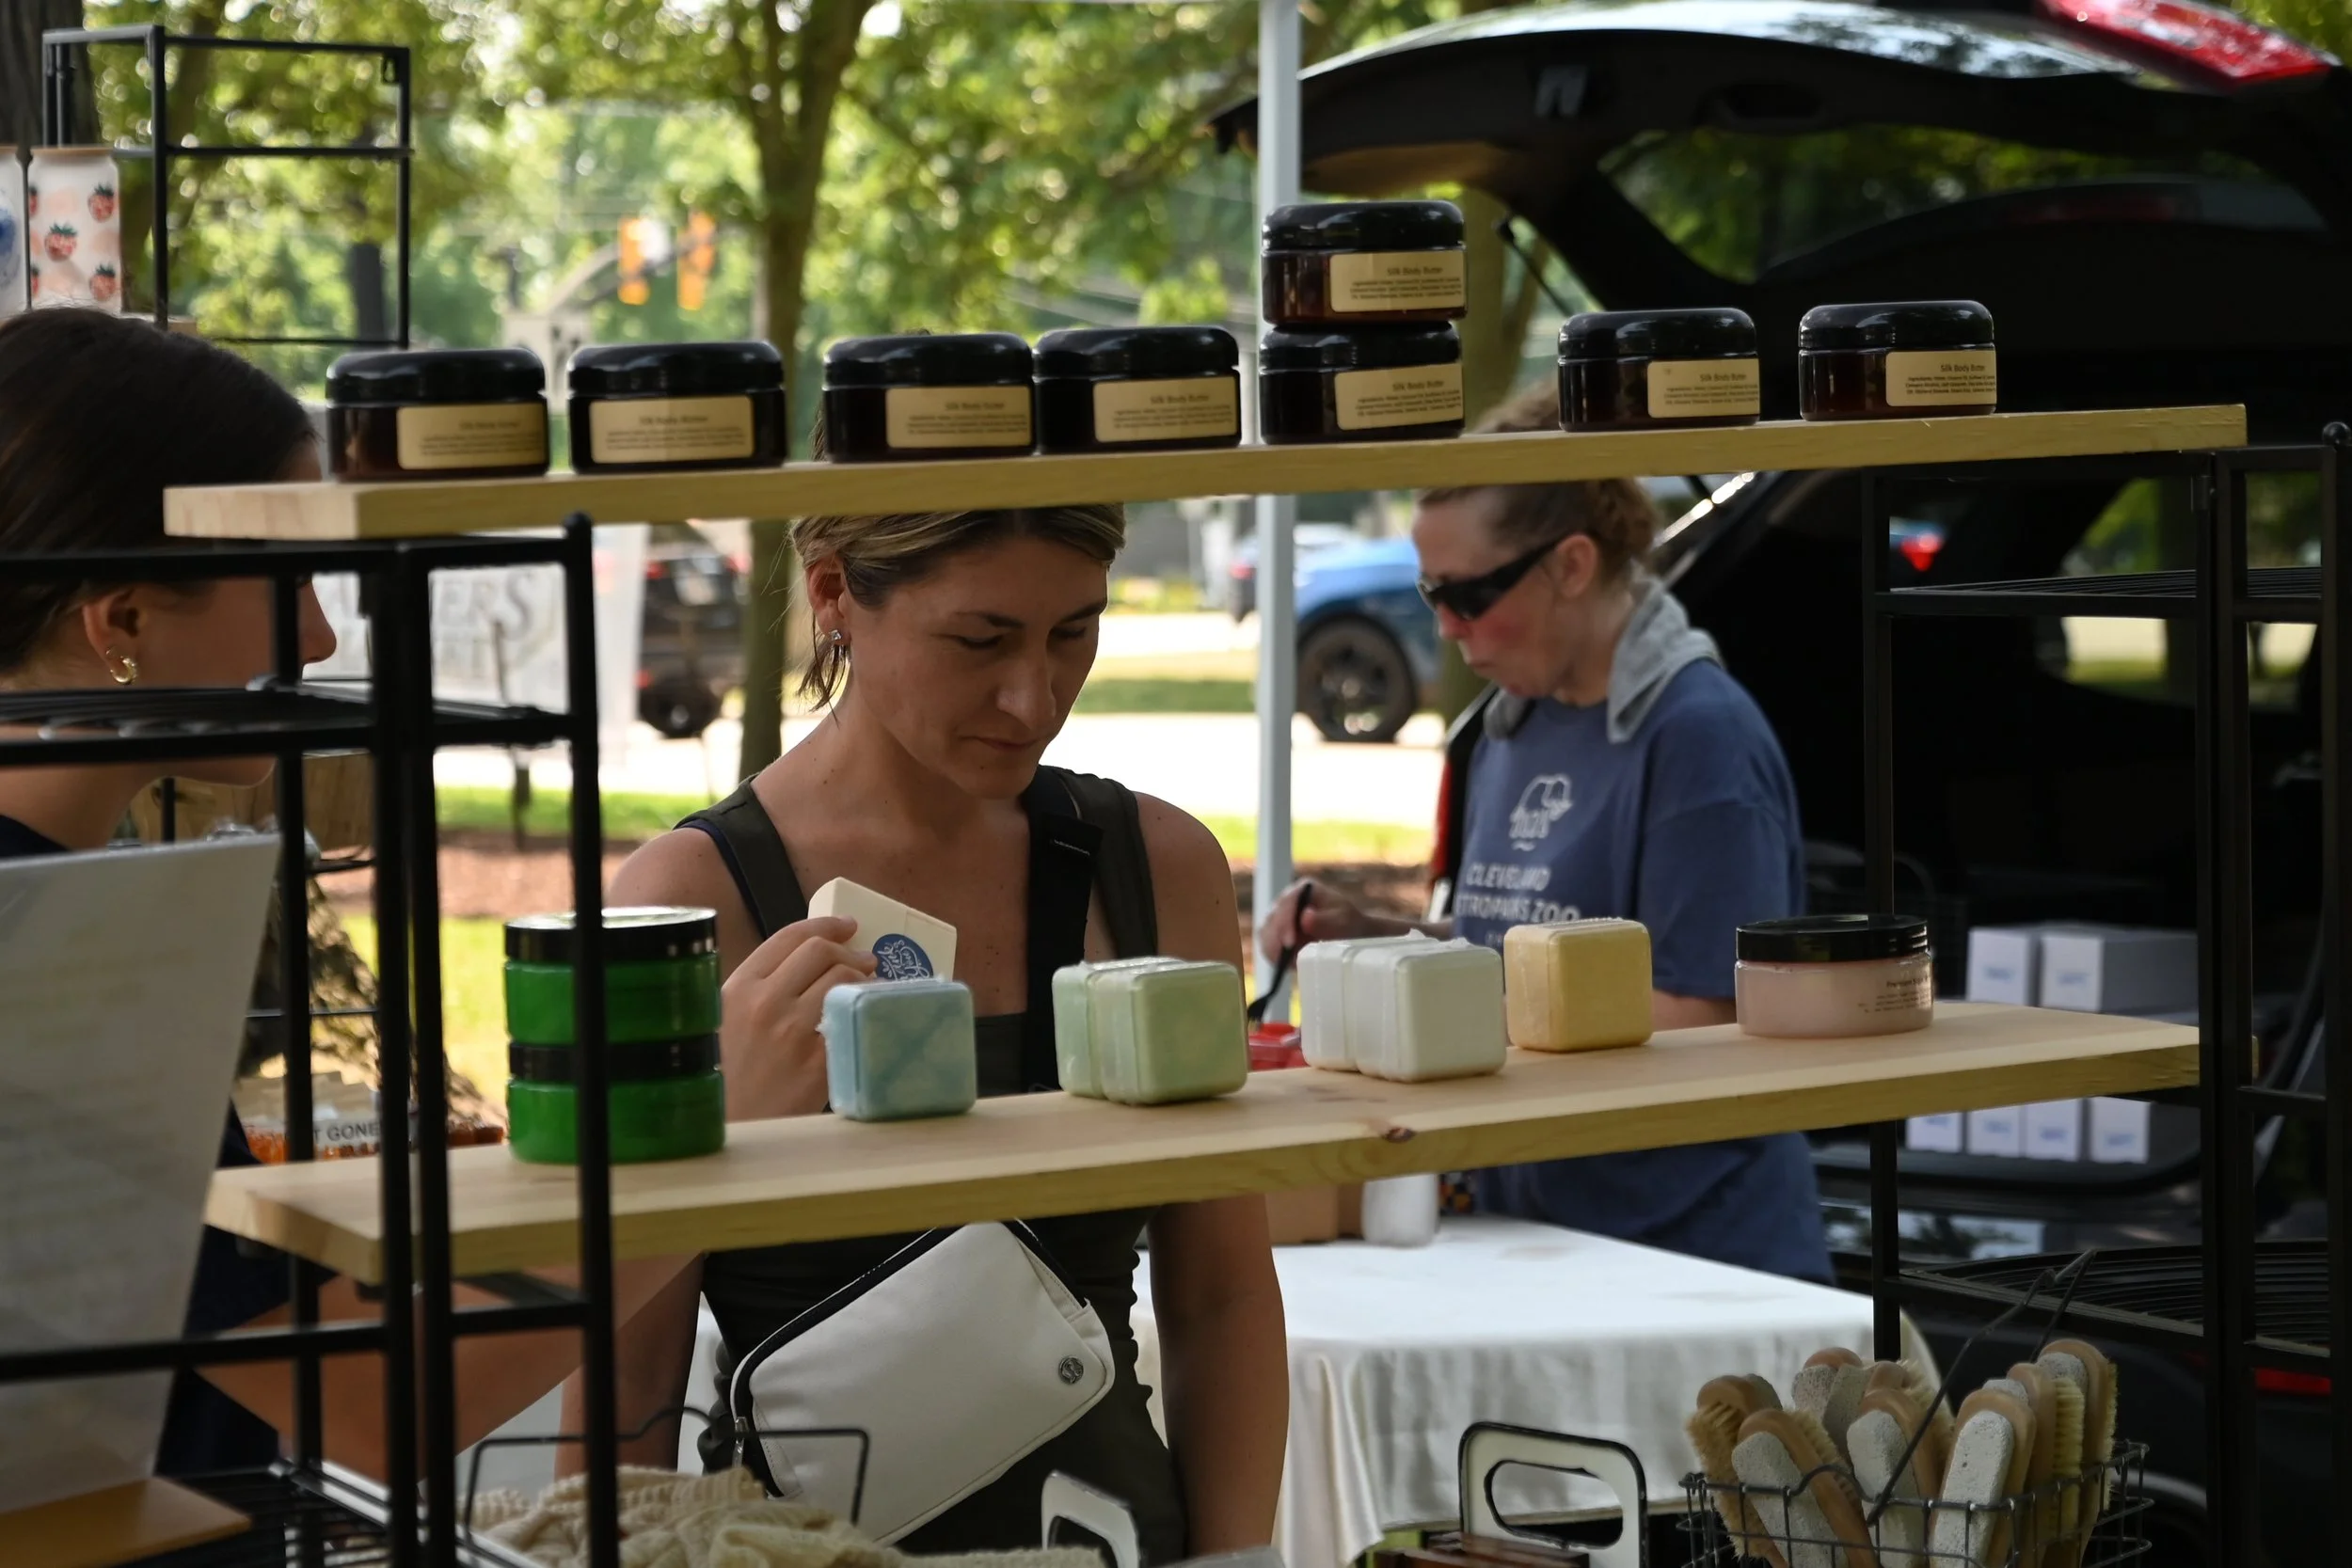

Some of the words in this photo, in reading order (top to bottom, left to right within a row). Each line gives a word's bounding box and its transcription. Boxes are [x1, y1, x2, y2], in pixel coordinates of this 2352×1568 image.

[1940, 364, 1953, 372] Silk
[1954, 364, 1969, 373] Body
[1455, 894, 1530, 923] ETROPARKS
